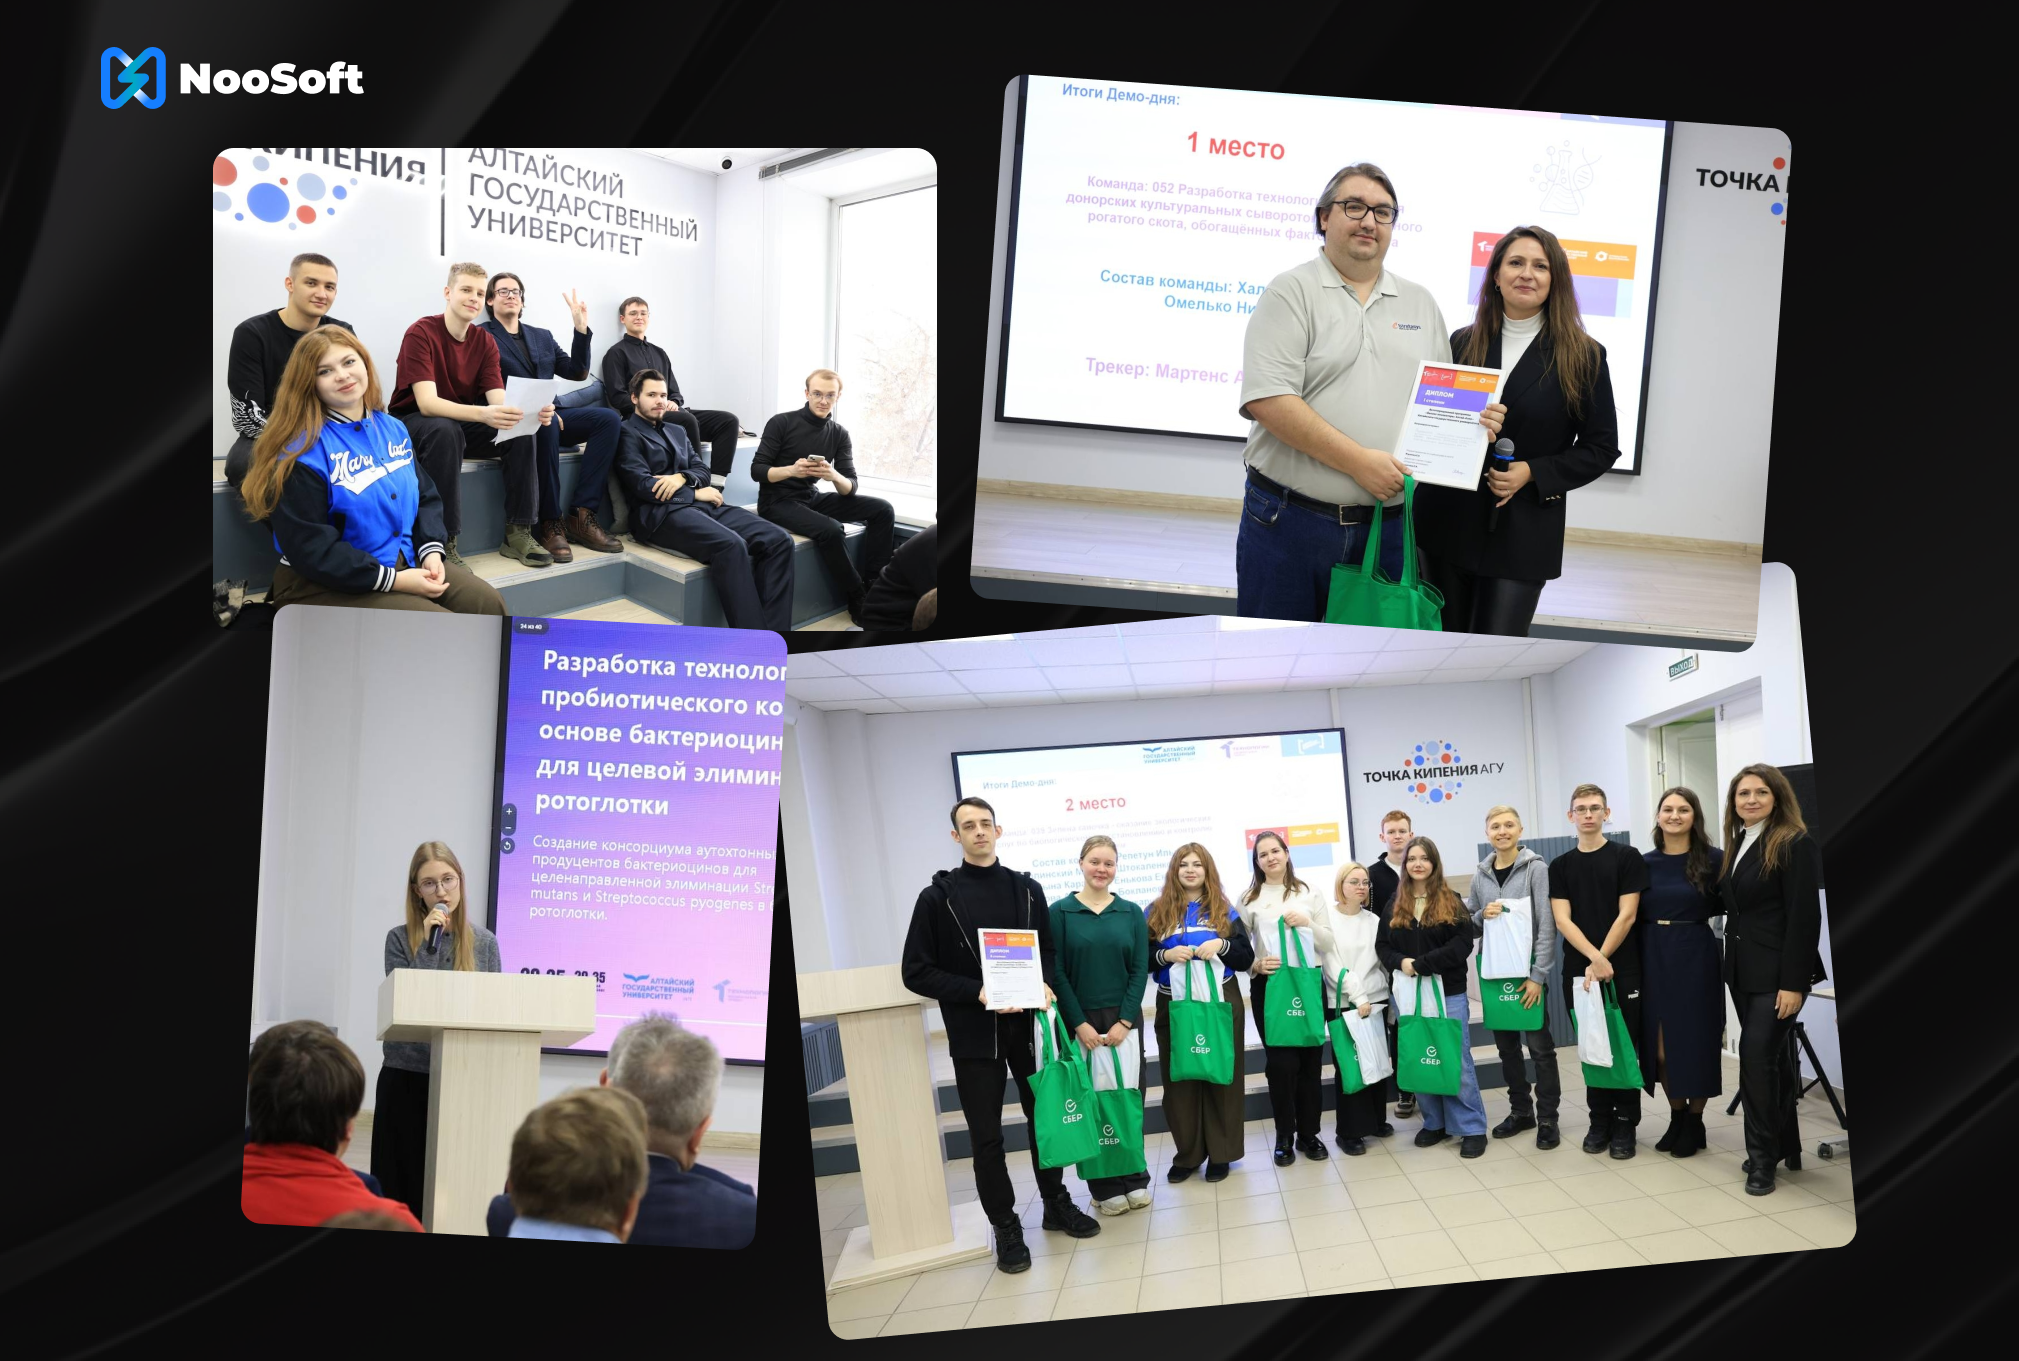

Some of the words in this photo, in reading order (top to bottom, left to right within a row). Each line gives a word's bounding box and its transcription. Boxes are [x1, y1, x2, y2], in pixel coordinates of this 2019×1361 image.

[1062, 83, 1103, 99] Итоги
[1106, 87, 1180, 105] Демо-дня:
[1187, 131, 1198, 152] 1
[1209, 138, 1285, 160] место
[468, 148, 623, 198] АЛТАЙСКИЙ
[1696, 168, 1780, 193] ТОЧКА
[1087, 175, 1148, 192] Команда:
[1152, 181, 1175, 194] 052
[1178, 183, 1252, 200] Разработка
[469, 173, 697, 241] ГОСУДАРСТВЕННЫЙ
[1066, 193, 1136, 207] донорских
[1140, 200, 1242, 217] культуральных
[467, 205, 643, 256] УНИВЕРСИТЕТ
[1088, 212, 1145, 226] рогатого
[1148, 217, 1187, 231] скота,
[1191, 219, 1281, 239] обогащённых
[1100, 269, 1154, 286] Состав
[1159, 278, 1232, 294] команды:
[1164, 295, 1232, 312] Омелько
[1086, 357, 1150, 379] Трекер:
[1155, 363, 1228, 383] Мартенс
[1424, 389, 1454, 398] ДИПЛОМ
[330, 450, 376, 483] Mary
[543, 650, 676, 677] Разработка
[1670, 658, 1693, 675] ВЫХОД
[541, 687, 748, 714] пробиотического
[539, 724, 622, 743] основе
[536, 759, 579, 779] для
[587, 761, 686, 781] целевой
[1363, 769, 1411, 783] ТОЧКА
[1414, 764, 1478, 779] КИПЕНИЯ
[1480, 762, 1504, 774] АГУ
[983, 782, 1009, 790] Итоги
[536, 793, 669, 815] ротоглотки
[1065, 798, 1074, 811] 2
[1080, 797, 1126, 811] место
[533, 835, 597, 851] Создание
[602, 841, 691, 857] консорциума
[532, 855, 620, 870] продуцентов
[624, 857, 729, 875] бактериоцинов
[733, 866, 757, 878] для
[1032, 859, 1066, 867] Состав
[531, 872, 661, 888] целенаправленной
[665, 880, 749, 895] элиминации
[531, 888, 578, 901] mutans
[583, 892, 591, 901] и
[596, 890, 685, 907] Streptococcus
[690, 898, 754, 913] pyogenes
[758, 902, 765, 911] в
[529, 906, 608, 920] ротоглотки.
[622, 984, 694, 994] ГОСУДАРСТВЕННЫЙ
[650, 977, 694, 986] АЛТАЙСКИЙ
[623, 992, 673, 1000] УНИВЕРСИТЕТ
[1190, 1046, 1211, 1054] СБЕР
[1421, 1057, 1441, 1065] СБЕР
[1062, 1113, 1083, 1124] СБЕР
